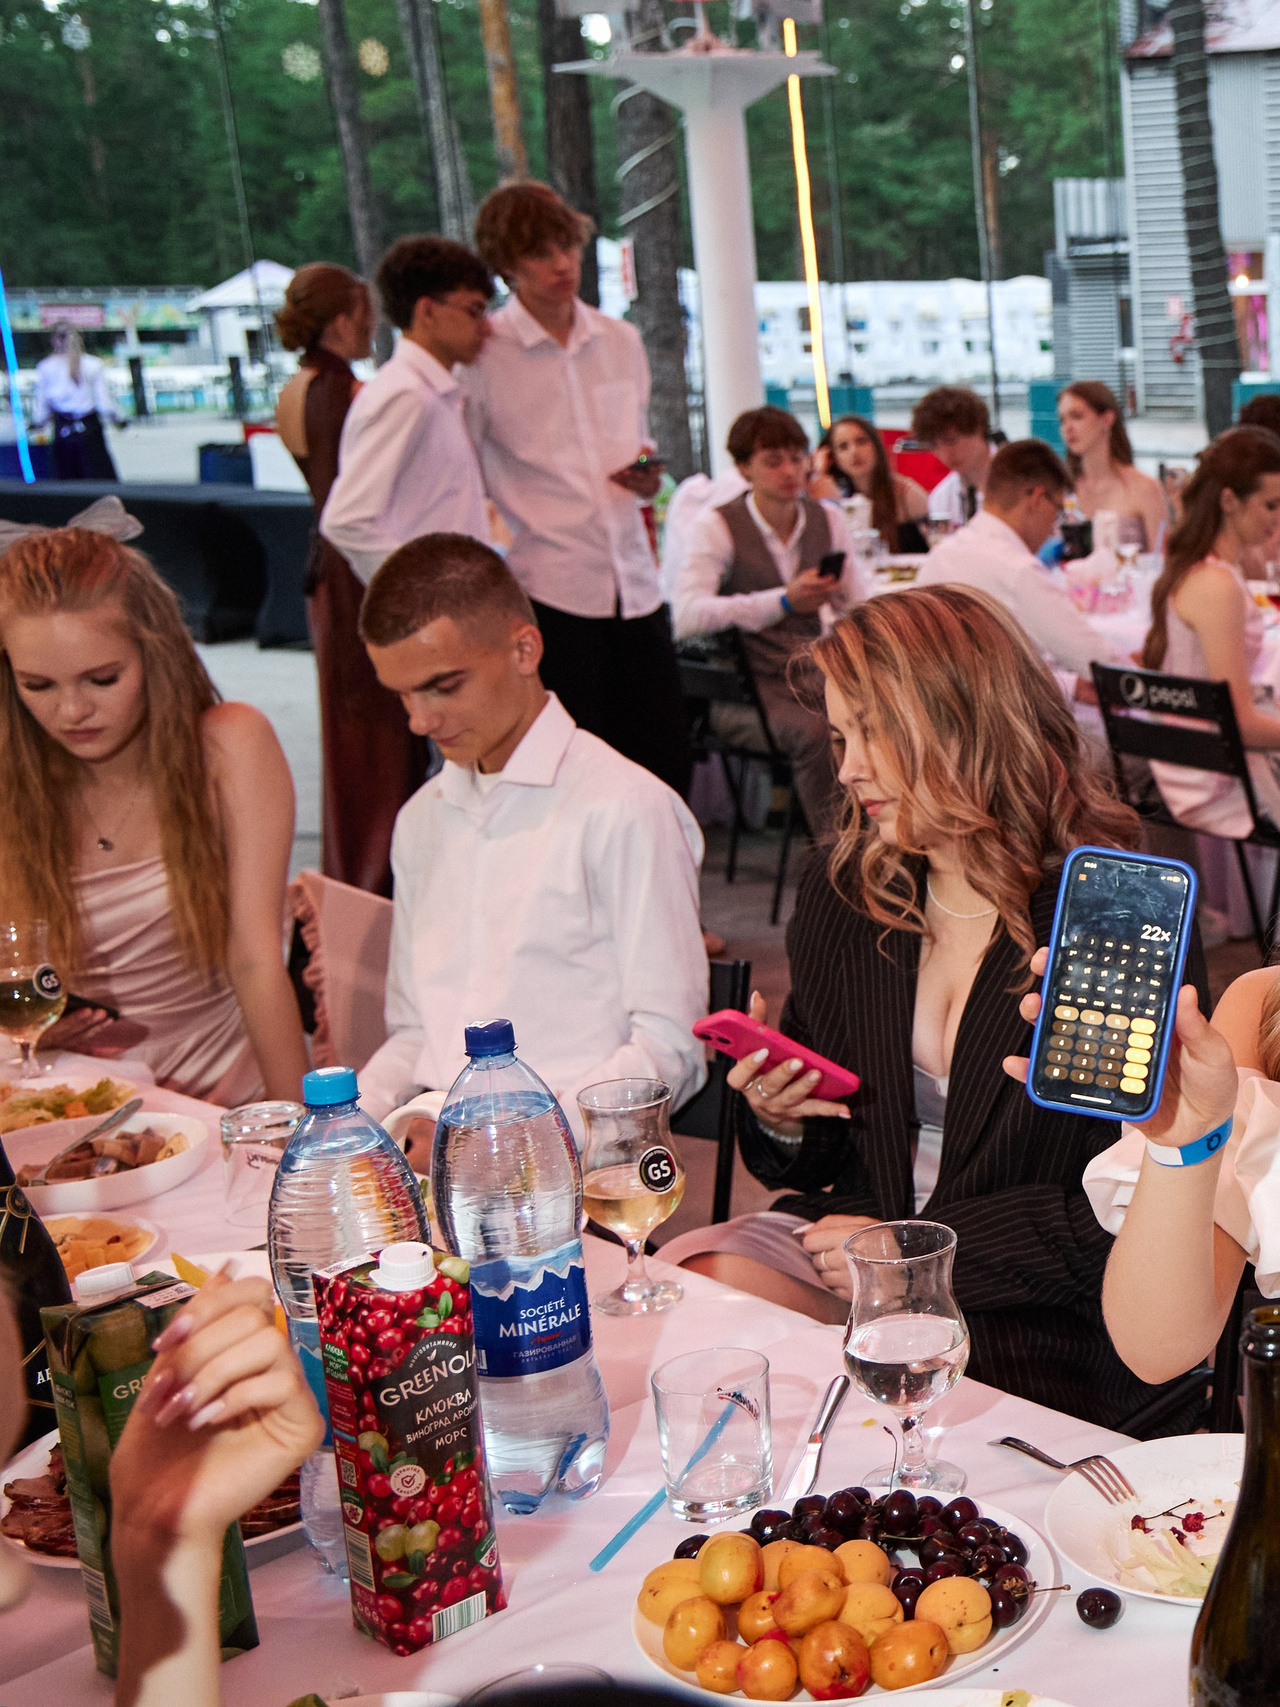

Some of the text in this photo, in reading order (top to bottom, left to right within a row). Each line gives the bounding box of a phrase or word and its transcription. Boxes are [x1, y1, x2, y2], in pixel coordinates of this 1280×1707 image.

[1149, 685, 1198, 710] pepsi
[647, 1159, 672, 1181] GS
[498, 1302, 582, 1339] MINÉRALE
[519, 1296, 566, 1320] SOCIÉTÉ
[415, 1388, 472, 1425] КЛЮКВА
[406, 1416, 452, 1444] ВИНОГРАД
[434, 1427, 468, 1450] МОРС
